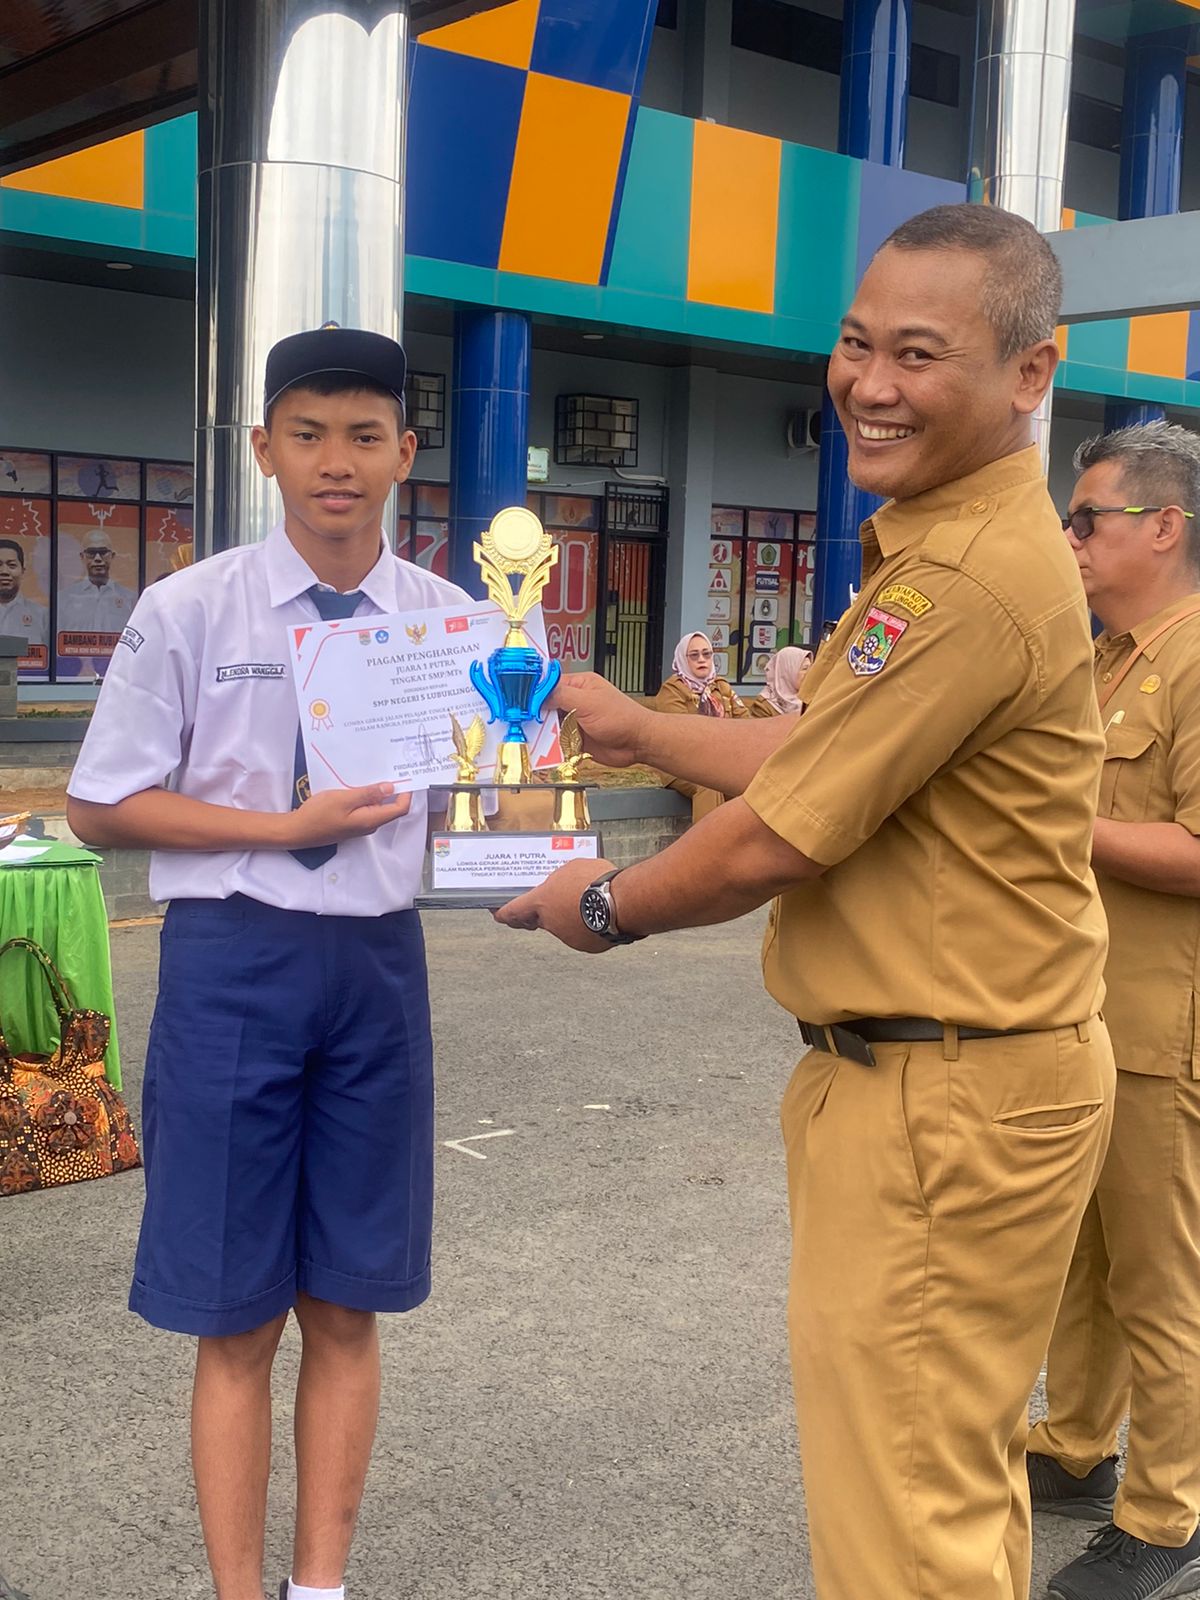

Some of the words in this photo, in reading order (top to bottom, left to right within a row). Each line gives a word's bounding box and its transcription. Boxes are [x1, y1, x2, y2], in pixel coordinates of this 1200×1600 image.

[756, 577, 779, 585] FUTSAL
[911, 592, 929, 610] KOTA
[64, 634, 97, 646] BAMBANG
[367, 654, 405, 667] PIAGAM
[407, 643, 480, 662] PENGHARGAAN
[396, 664, 421, 676] JUARA
[429, 659, 456, 670] PUTRA
[391, 673, 427, 686] TINGKAT
[373, 699, 390, 708] SMP
[390, 694, 420, 706] NEGERI
[427, 686, 477, 700] LUBUKLINGG
[384, 714, 404, 723] JALAN
